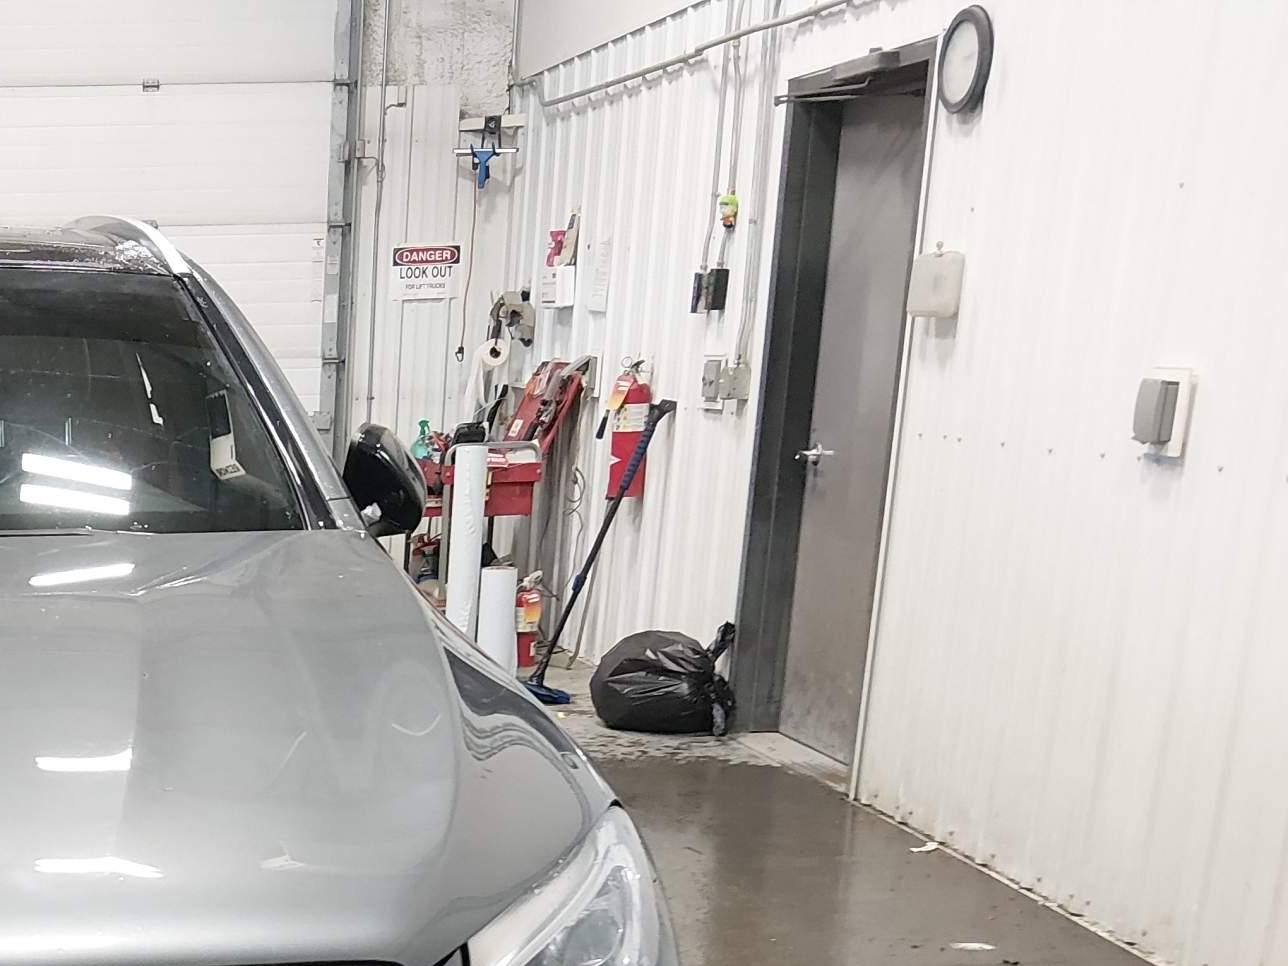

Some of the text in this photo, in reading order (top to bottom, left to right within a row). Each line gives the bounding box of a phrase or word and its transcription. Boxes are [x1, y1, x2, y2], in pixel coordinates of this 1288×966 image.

[402, 250, 451, 262] DANGER
[399, 265, 453, 279] LOOK OUT
